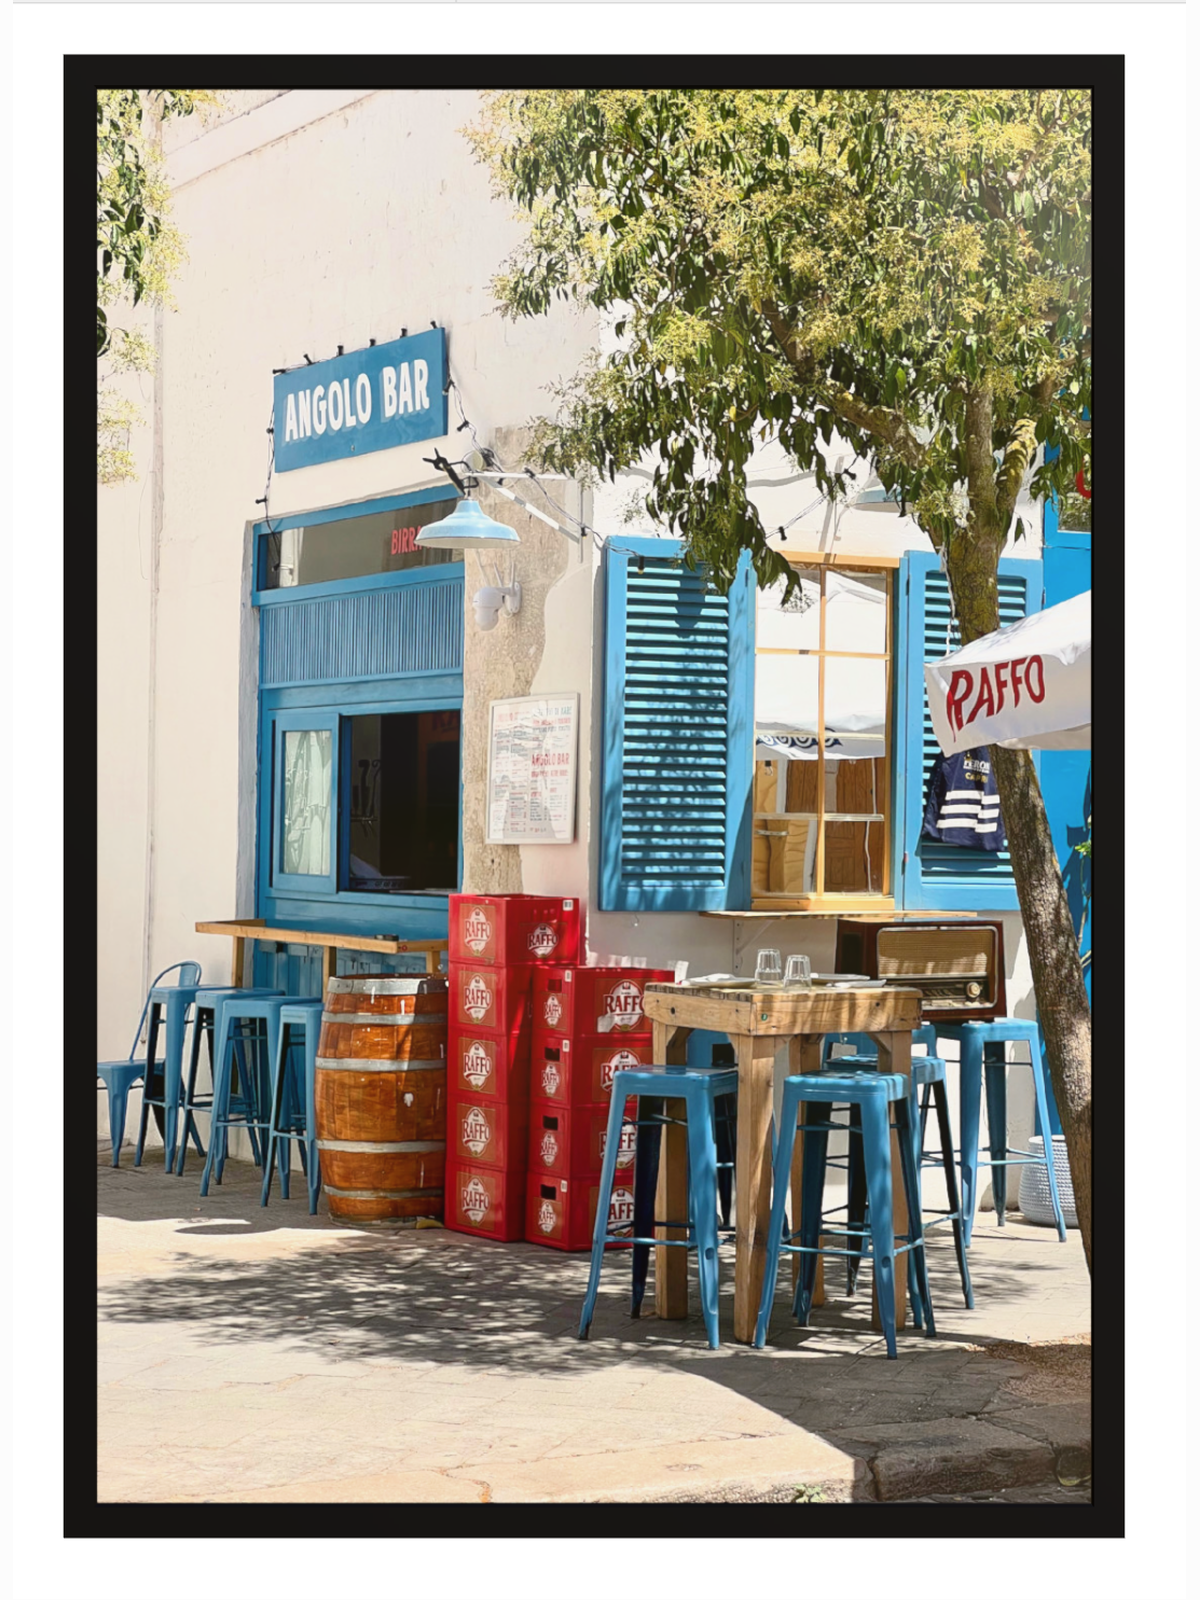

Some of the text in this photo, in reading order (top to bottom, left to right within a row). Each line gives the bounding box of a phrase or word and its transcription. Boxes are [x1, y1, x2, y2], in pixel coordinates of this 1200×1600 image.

[285, 359, 430, 442] ANGOLO BAR
[946, 655, 1045, 742] RAFFO
[557, 753, 569, 765] BAR
[465, 920, 491, 939] RAFFO
[529, 934, 558, 947] RAFFO
[465, 988, 490, 1008] RAFFO
[464, 1054, 490, 1074] RAFFO
[463, 1120, 489, 1140] RAFFO
[462, 1188, 489, 1209] RAFFO
[608, 1203, 633, 1220] AFF
